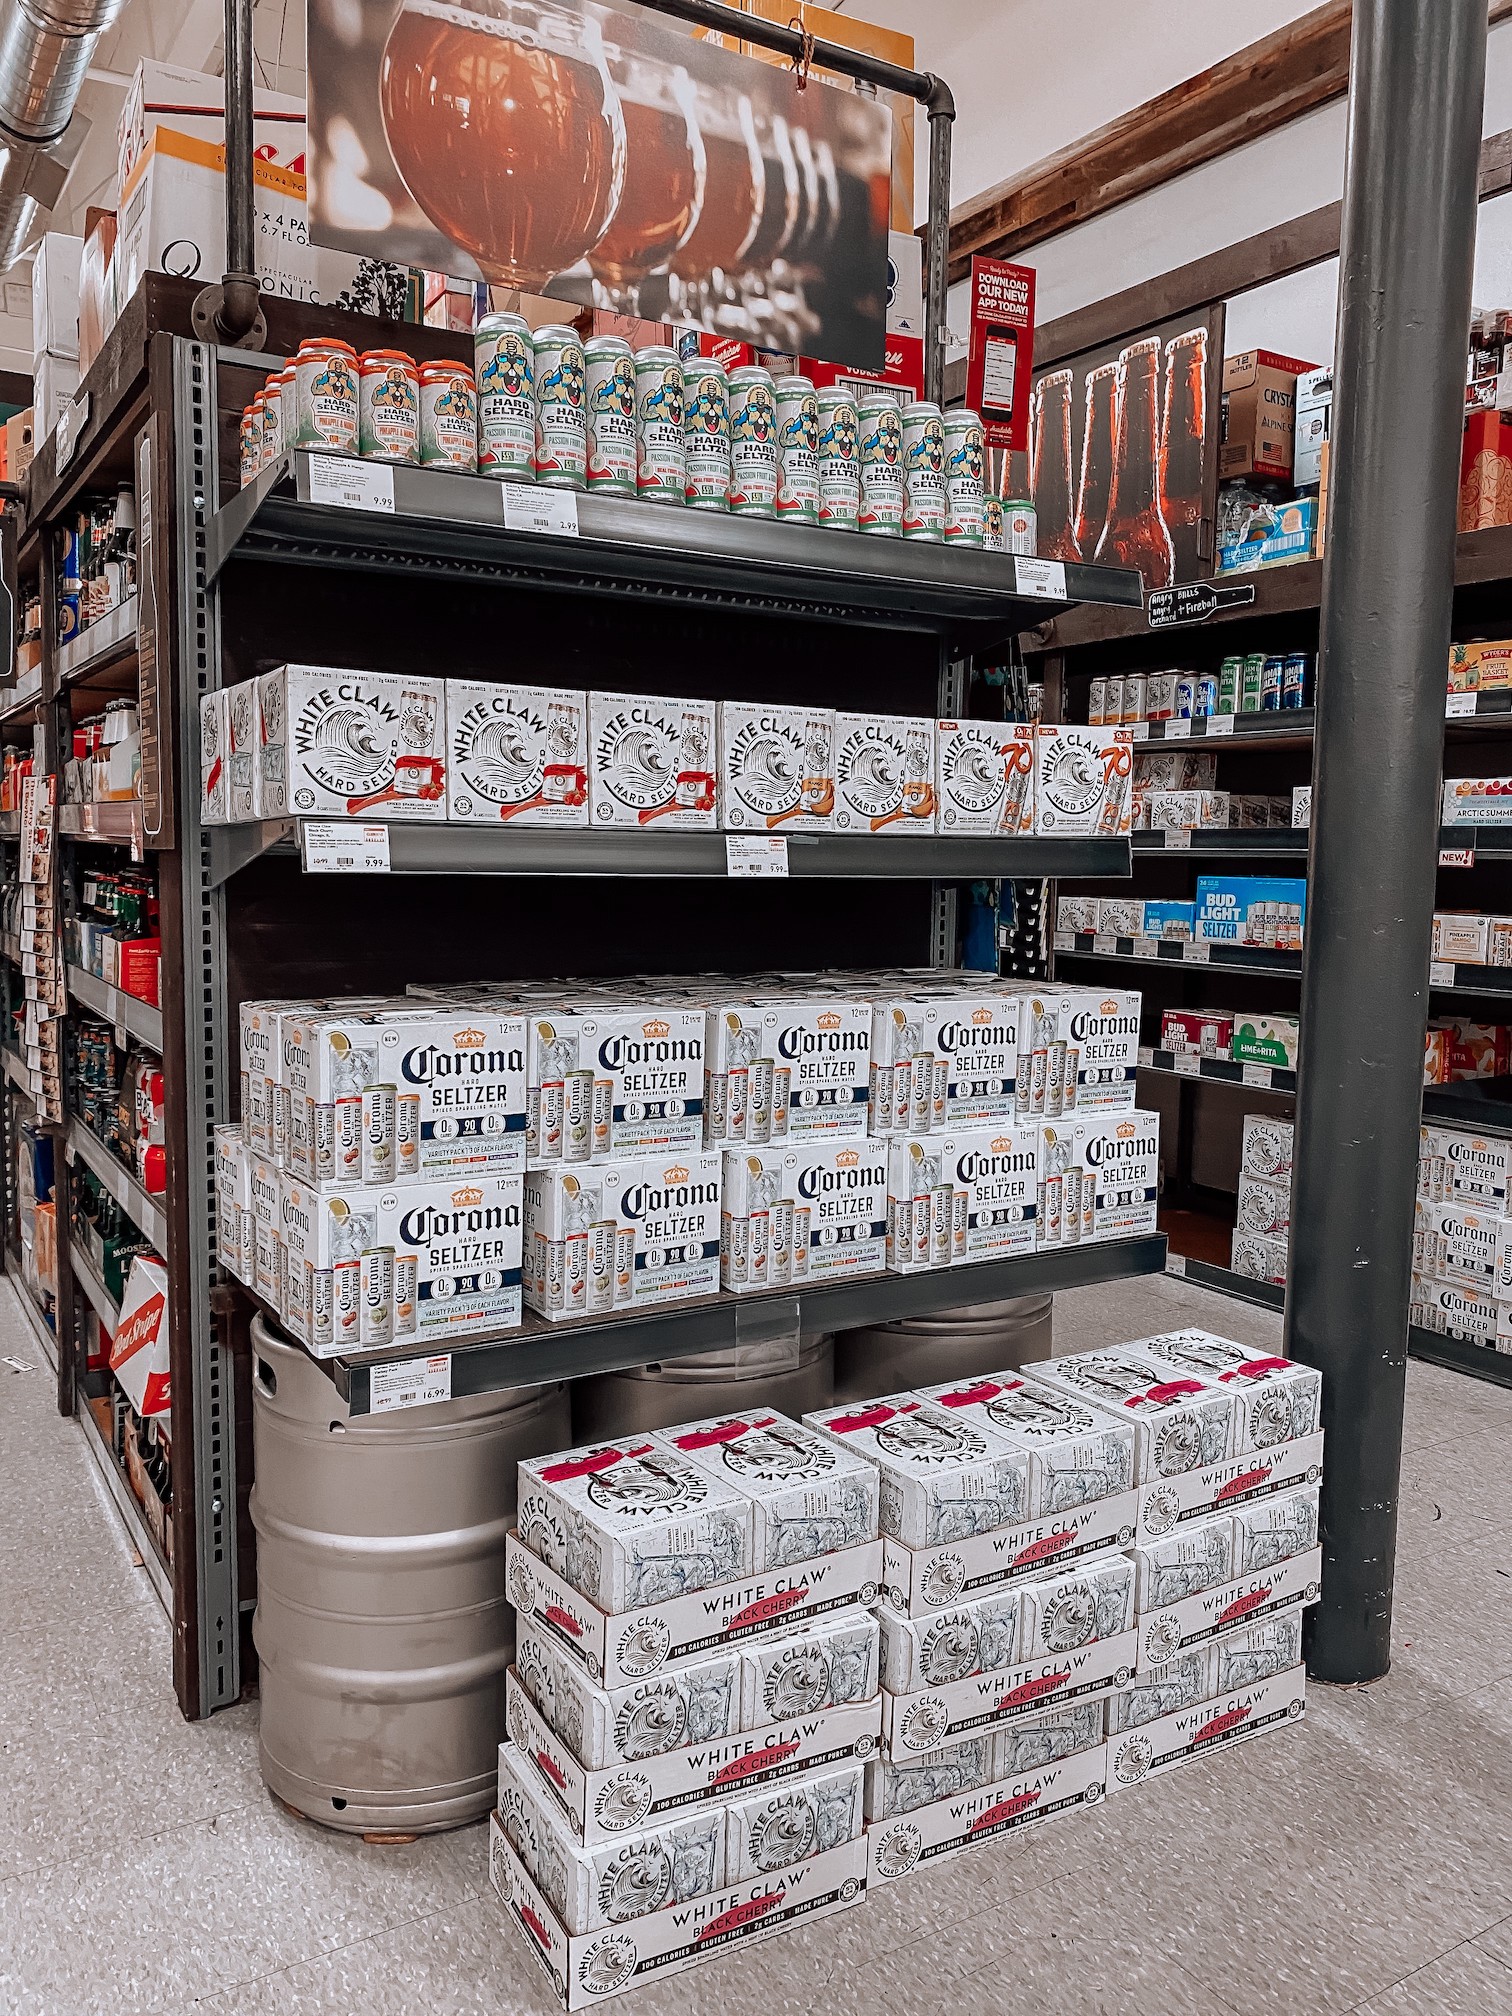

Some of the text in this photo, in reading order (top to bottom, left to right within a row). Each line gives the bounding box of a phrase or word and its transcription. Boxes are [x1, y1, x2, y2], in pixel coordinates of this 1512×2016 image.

[276, 214, 284, 226] 4
[261, 225, 292, 242] 6.7 FL
[161, 239, 201, 279] Q
[259, 265, 313, 285] SPECTACULAR
[978, 272, 1028, 292] DOWNLOAD
[254, 273, 320, 305] ONIC
[978, 284, 1028, 304] OUR NEW
[978, 296, 1028, 316] APP TODAY!
[1230, 364, 1252, 374] BOTTLES
[324, 398, 351, 408] HARD
[493, 398, 530, 410] HARD
[1264, 388, 1295, 408] CRYSTA
[384, 408, 410, 416] HARD
[445, 417, 471, 427] HARD
[694, 436, 727, 446] HARD
[374, 496, 393, 506] 9.99
[560, 521, 577, 530] 2.99
[1054, 587, 1066, 596] 9.99
[1186, 596, 1217, 614] Fireball
[1482, 668, 1508, 676] BASKET
[295, 684, 400, 754] WHITE CLAW
[455, 698, 546, 763] WHITE CLAW
[598, 708, 680, 772] WHITE CLAW
[728, 718, 804, 780] WHITE CLAW
[942, 730, 1002, 780] WHITE CLAW
[1000, 743, 1032, 783] 70
[1042, 734, 1102, 786] WHITE CLAW
[1100, 745, 1132, 785] 70
[315, 766, 356, 792] HARD
[472, 776, 510, 798] HARD
[613, 782, 645, 804] HARD
[744, 790, 772, 810] HARD
[954, 791, 978, 809] HARD
[1053, 793, 1076, 810] HARD
[1457, 809, 1512, 817] ARCTIC SUMME
[365, 858, 384, 868] 9.99
[1442, 850, 1470, 865] NEW!
[770, 864, 784, 873] 9.99
[1206, 893, 1236, 906] BUD
[1200, 906, 1242, 922] LIGHT
[1202, 922, 1238, 940] SELTZER
[500, 1024, 508, 1034] 12
[1070, 1011, 1138, 1044] Corona
[1164, 1030, 1188, 1042] LIGHT
[1168, 1022, 1186, 1033] BUD
[778, 1025, 870, 1063] Corona
[938, 1021, 1016, 1056] Corona
[1166, 1040, 1186, 1053] SELTZER
[599, 1034, 702, 1074] Corona
[1085, 1043, 1128, 1059] SELTZER
[402, 1044, 525, 1088] Corona
[800, 1060, 856, 1078] SELTZER
[956, 1054, 1005, 1072] SELTZER
[624, 1072, 687, 1091] SELTZER
[432, 1084, 508, 1107] SELTZER
[1086, 1136, 1156, 1170] Corona
[1448, 1142, 1506, 1169] Corona
[956, 1150, 1036, 1186] Corona
[1102, 1165, 1147, 1184] SELTZER
[1460, 1163, 1496, 1181] SELTZER
[798, 1163, 886, 1200] Corona
[976, 1181, 1025, 1201] SELTZER
[620, 1181, 719, 1222] Corona
[818, 1197, 874, 1218] SELTZER
[400, 1204, 522, 1249] Corona
[645, 1215, 705, 1240] SELTZER
[458, 1236, 478, 1244] HARD
[430, 1240, 504, 1266] SELTZER
[425, 1305, 462, 1316] VARIETY PACK
[492, 1298, 510, 1308] FLAVOR
[112, 1308, 160, 1362] Red Stripe
[423, 1388, 445, 1400] 16.99
[1202, 1451, 1284, 1486] WHITE CLAW
[992, 1512, 1093, 1554] WHITE CLAW
[1008, 1534, 1078, 1564] BLACK CHERRY
[703, 1567, 827, 1614] WHITE CLAW
[1203, 1574, 1284, 1612] WHITE CLAW
[721, 1593, 808, 1627] BLACK CHERRY
[977, 1653, 1088, 1696] WHITE CLAW
[1175, 1690, 1264, 1732] WHITE CLAW
[687, 1720, 820, 1770] WHITE CLAW
[707, 1744, 799, 1782] BLACK CHERRY
[949, 1771, 1057, 1819] WHITE CLAW
[672, 1870, 806, 1928] WHITE CLAW
[693, 1896, 784, 1938] BLACK CHERRY
[641, 1960, 654, 1970] 100
[656, 1946, 690, 1966] CALORIES
[700, 1934, 726, 1950] GLUTEN
[728, 1928, 744, 1940] FREE
[754, 1921, 762, 1930] 2g
[764, 1912, 785, 1926] CARBS
[794, 1903, 812, 1915] MADE
